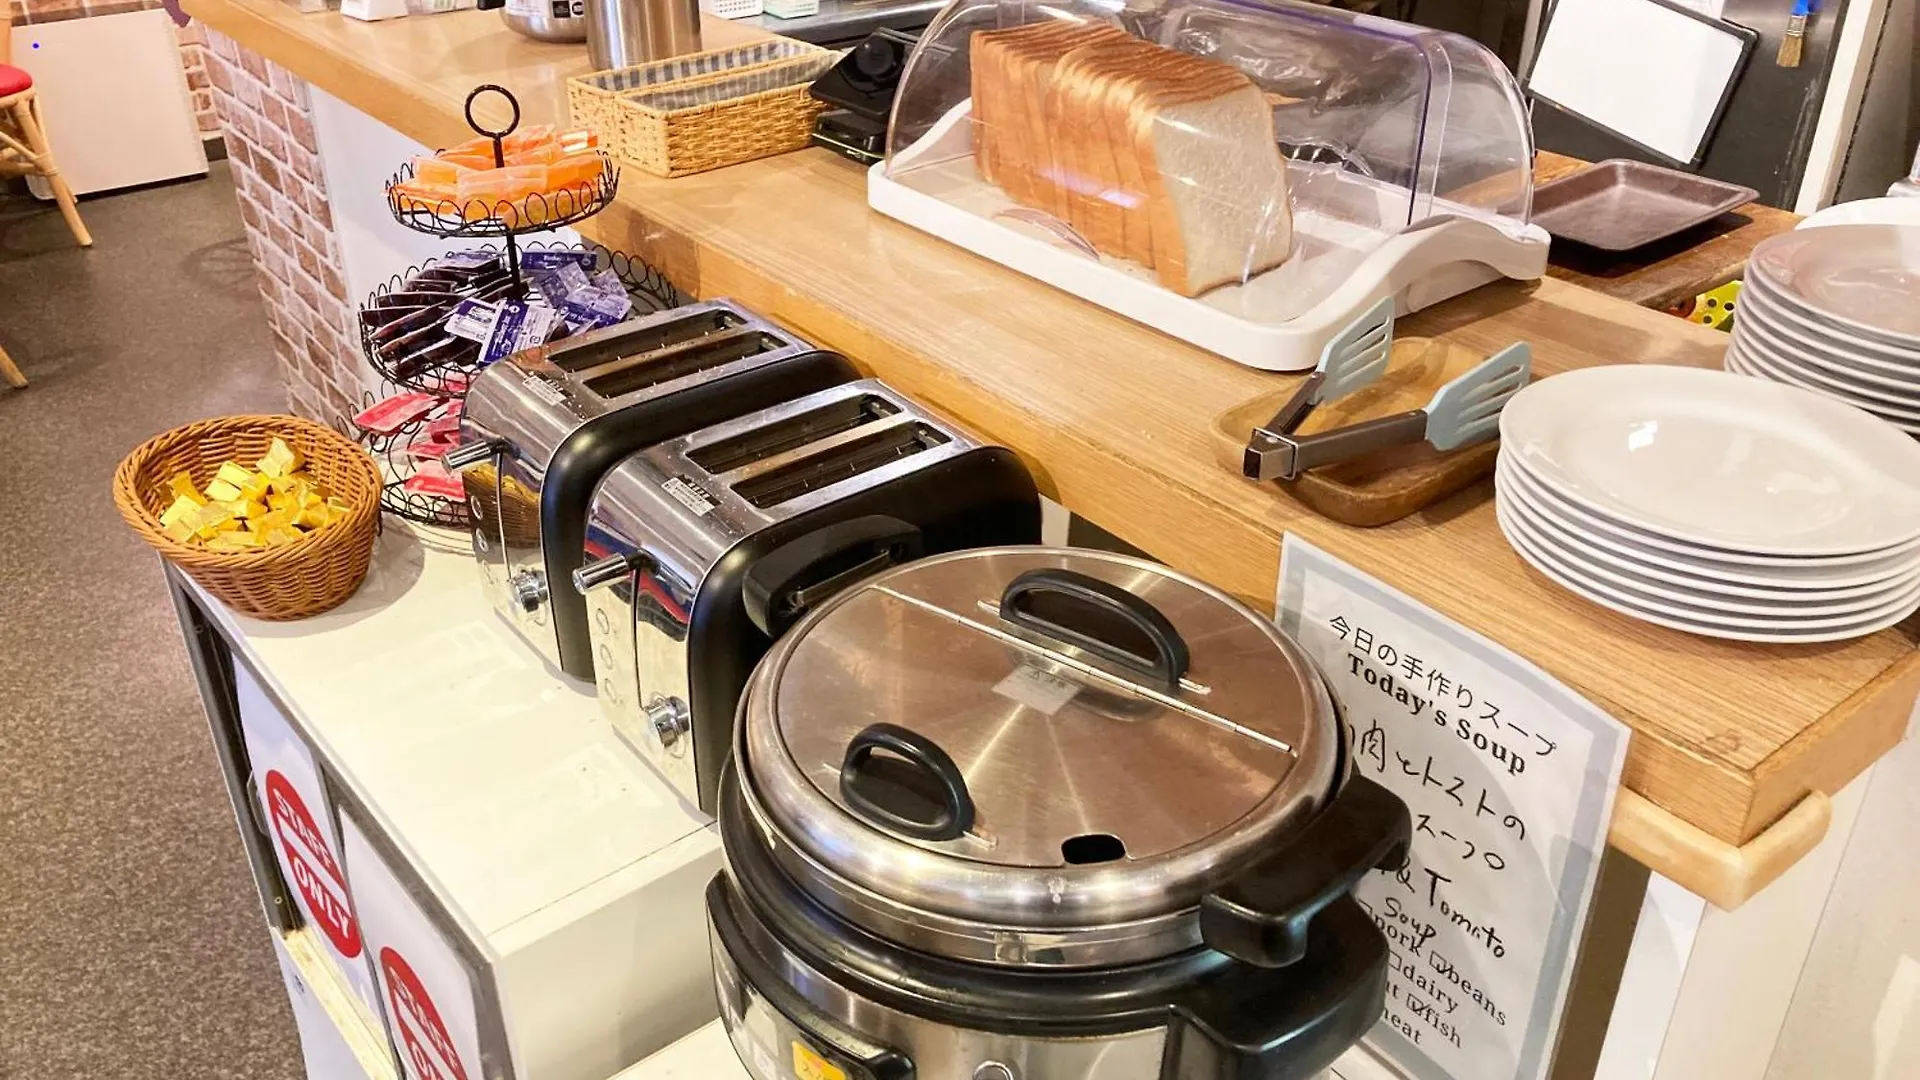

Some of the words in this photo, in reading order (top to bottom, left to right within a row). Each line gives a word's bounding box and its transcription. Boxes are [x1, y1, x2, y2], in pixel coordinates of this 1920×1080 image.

[1329, 615, 1557, 756] 今日の手作りスープ
[1347, 653, 1447, 727] Today's
[1456, 718, 1526, 776] Soup
[272, 787, 331, 869] STAFF
[293, 856, 350, 940] ONLY
[1383, 896, 1437, 946] Soup
[1402, 964, 1459, 1014] dairy
[1446, 963, 1506, 1027] beans
[1424, 1007, 1462, 1049] fish
